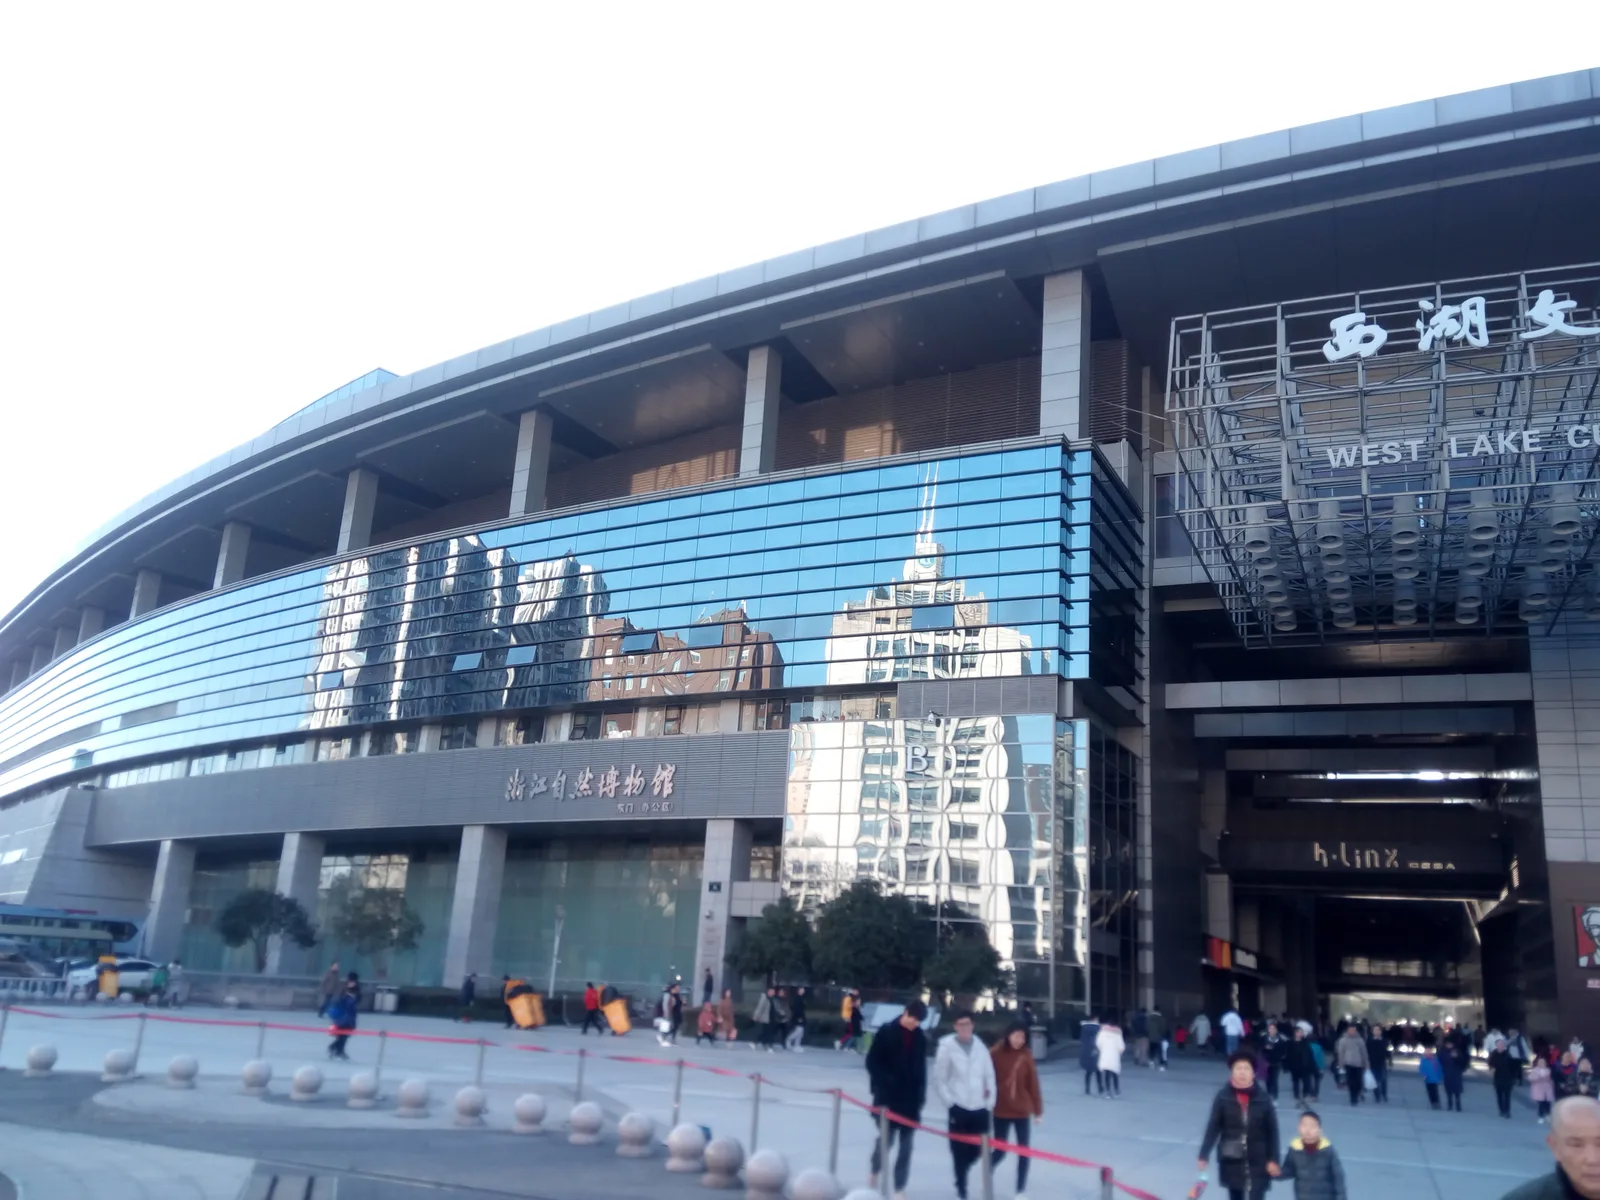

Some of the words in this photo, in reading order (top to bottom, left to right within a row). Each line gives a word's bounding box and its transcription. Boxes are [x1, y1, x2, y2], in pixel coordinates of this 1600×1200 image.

[1327, 440, 1424, 468] WEST
[1450, 429, 1542, 458] LAKE
[905, 744, 929, 772] B
[504, 763, 677, 801] 浙江自然博物馆
